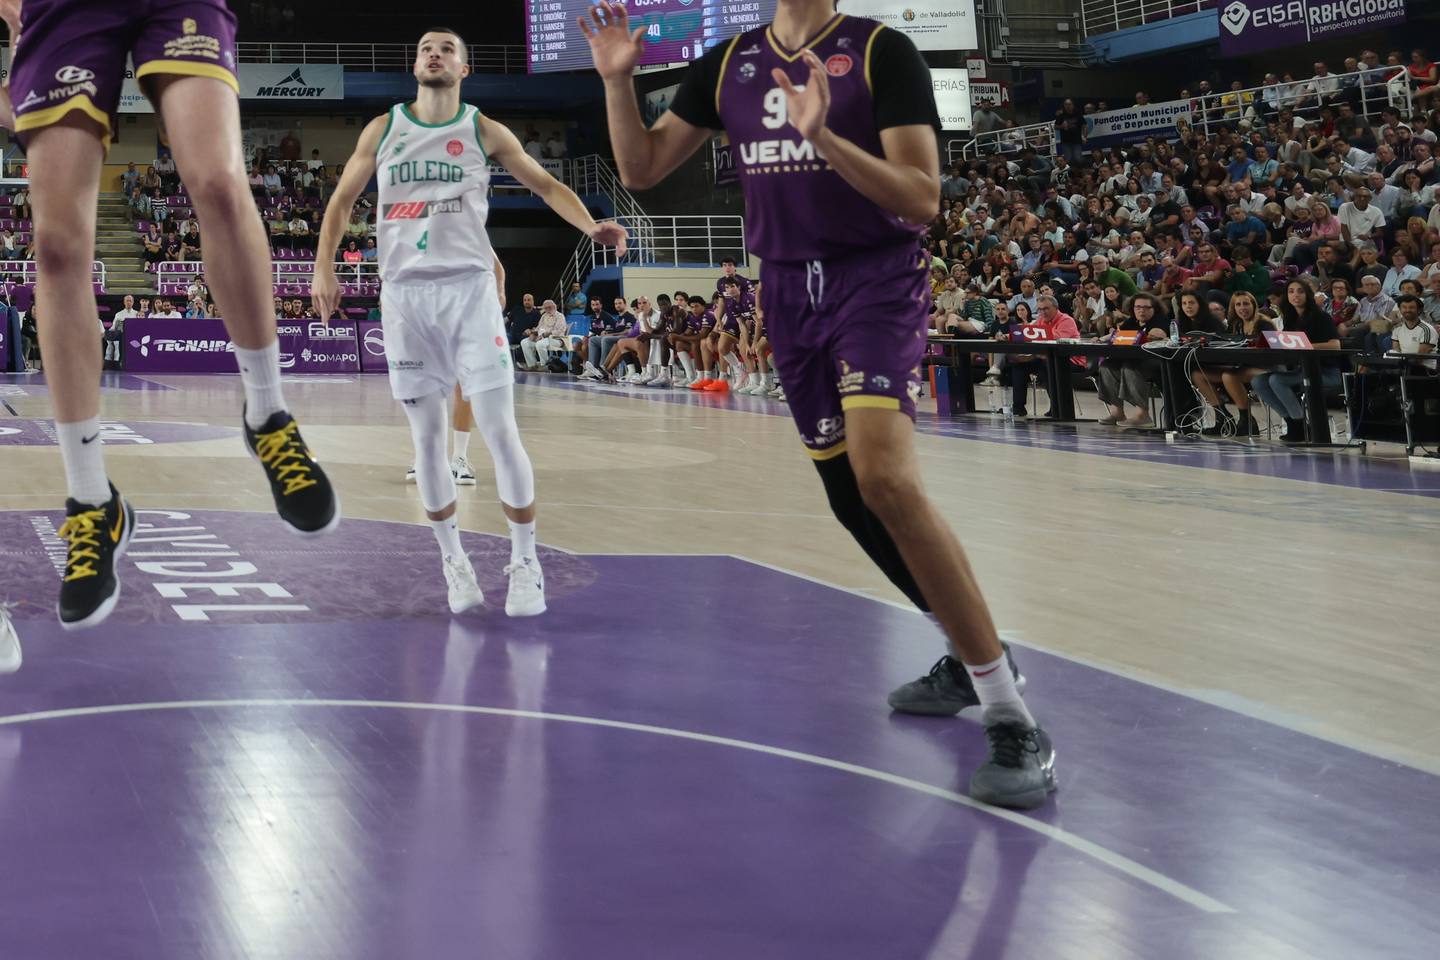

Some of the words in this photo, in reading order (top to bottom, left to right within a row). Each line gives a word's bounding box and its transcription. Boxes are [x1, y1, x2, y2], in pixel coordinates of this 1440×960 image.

[729, 2, 759, 13] VILLAREJO
[930, 10, 966, 18] Valladolid
[1252, 1, 1304, 28] EISA
[647, 24, 660, 36] 40
[1312, 26, 1319, 34] La
[1320, 19, 1357, 34] perspectiva
[1358, 16, 1366, 24] en
[682, 46, 688, 58] 0
[933, 78, 966, 91] ERÍAS
[970, 86, 999, 94] TRIBUNA
[256, 86, 326, 97] MERCURY
[1002, 87, 1010, 102] A
[1094, 112, 1138, 126] Fundación
[1141, 104, 1190, 118] Municipal
[1111, 122, 1121, 131] de
[1124, 117, 1172, 129] Deportes
[740, 140, 826, 165] UEM
[388, 160, 464, 186] TOLEDO
[313, 354, 357, 362] JOMAPO
